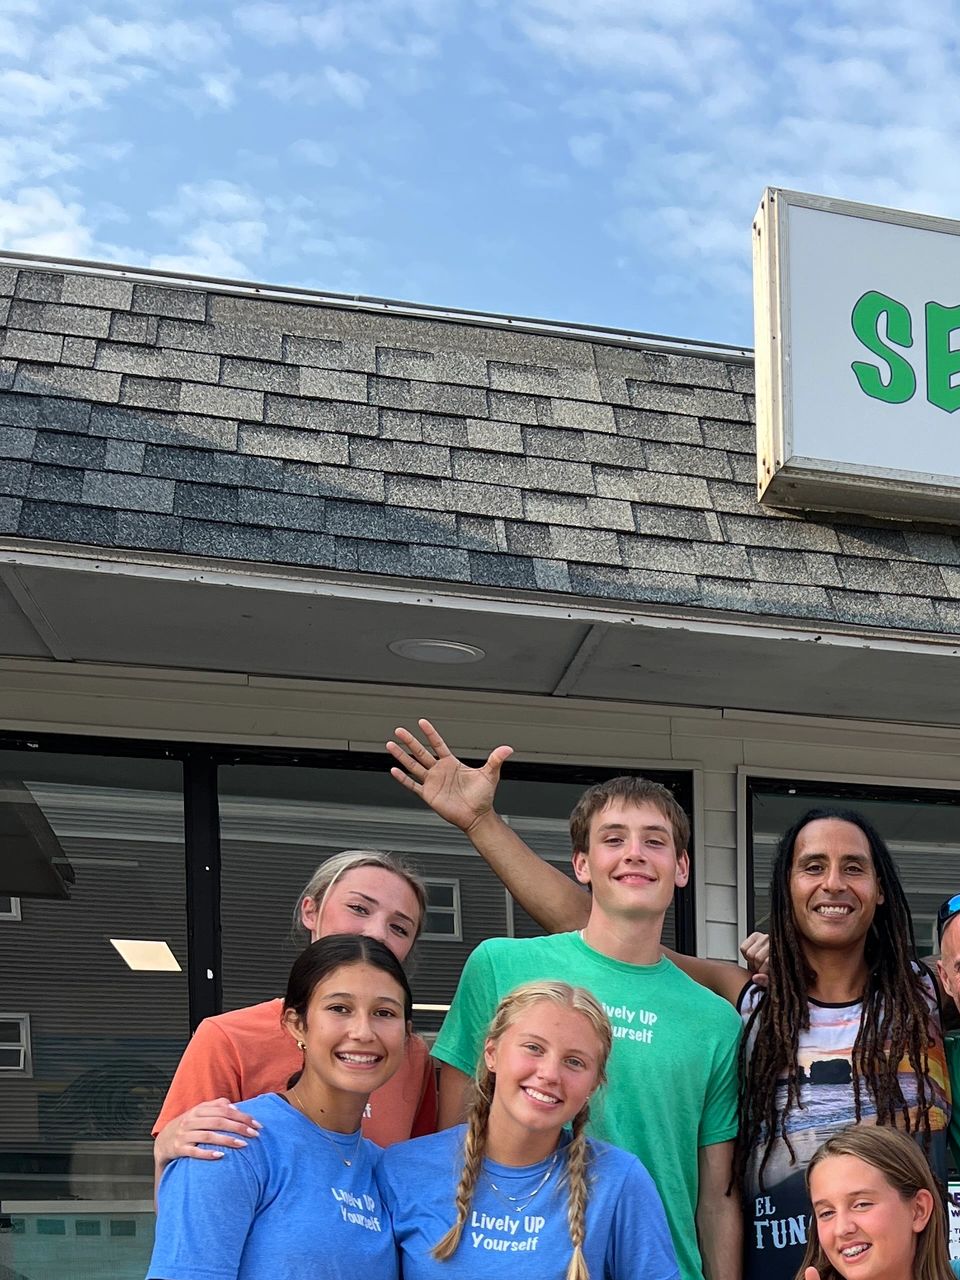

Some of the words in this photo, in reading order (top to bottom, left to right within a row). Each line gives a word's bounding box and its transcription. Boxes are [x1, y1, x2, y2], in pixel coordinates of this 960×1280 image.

[601, 1002, 636, 1024] ively
[639, 1009, 658, 1026] UP
[611, 1026, 654, 1044] urself
[331, 1187, 363, 1211] Lively
[363, 1193, 375, 1213] UP
[755, 1195, 776, 1217] EL
[340, 1204, 382, 1232] Yourself
[471, 1210, 520, 1235] Lively
[524, 1216, 546, 1234] UP
[471, 1232, 538, 1252] Yourself
[754, 1214, 811, 1250] TUN
